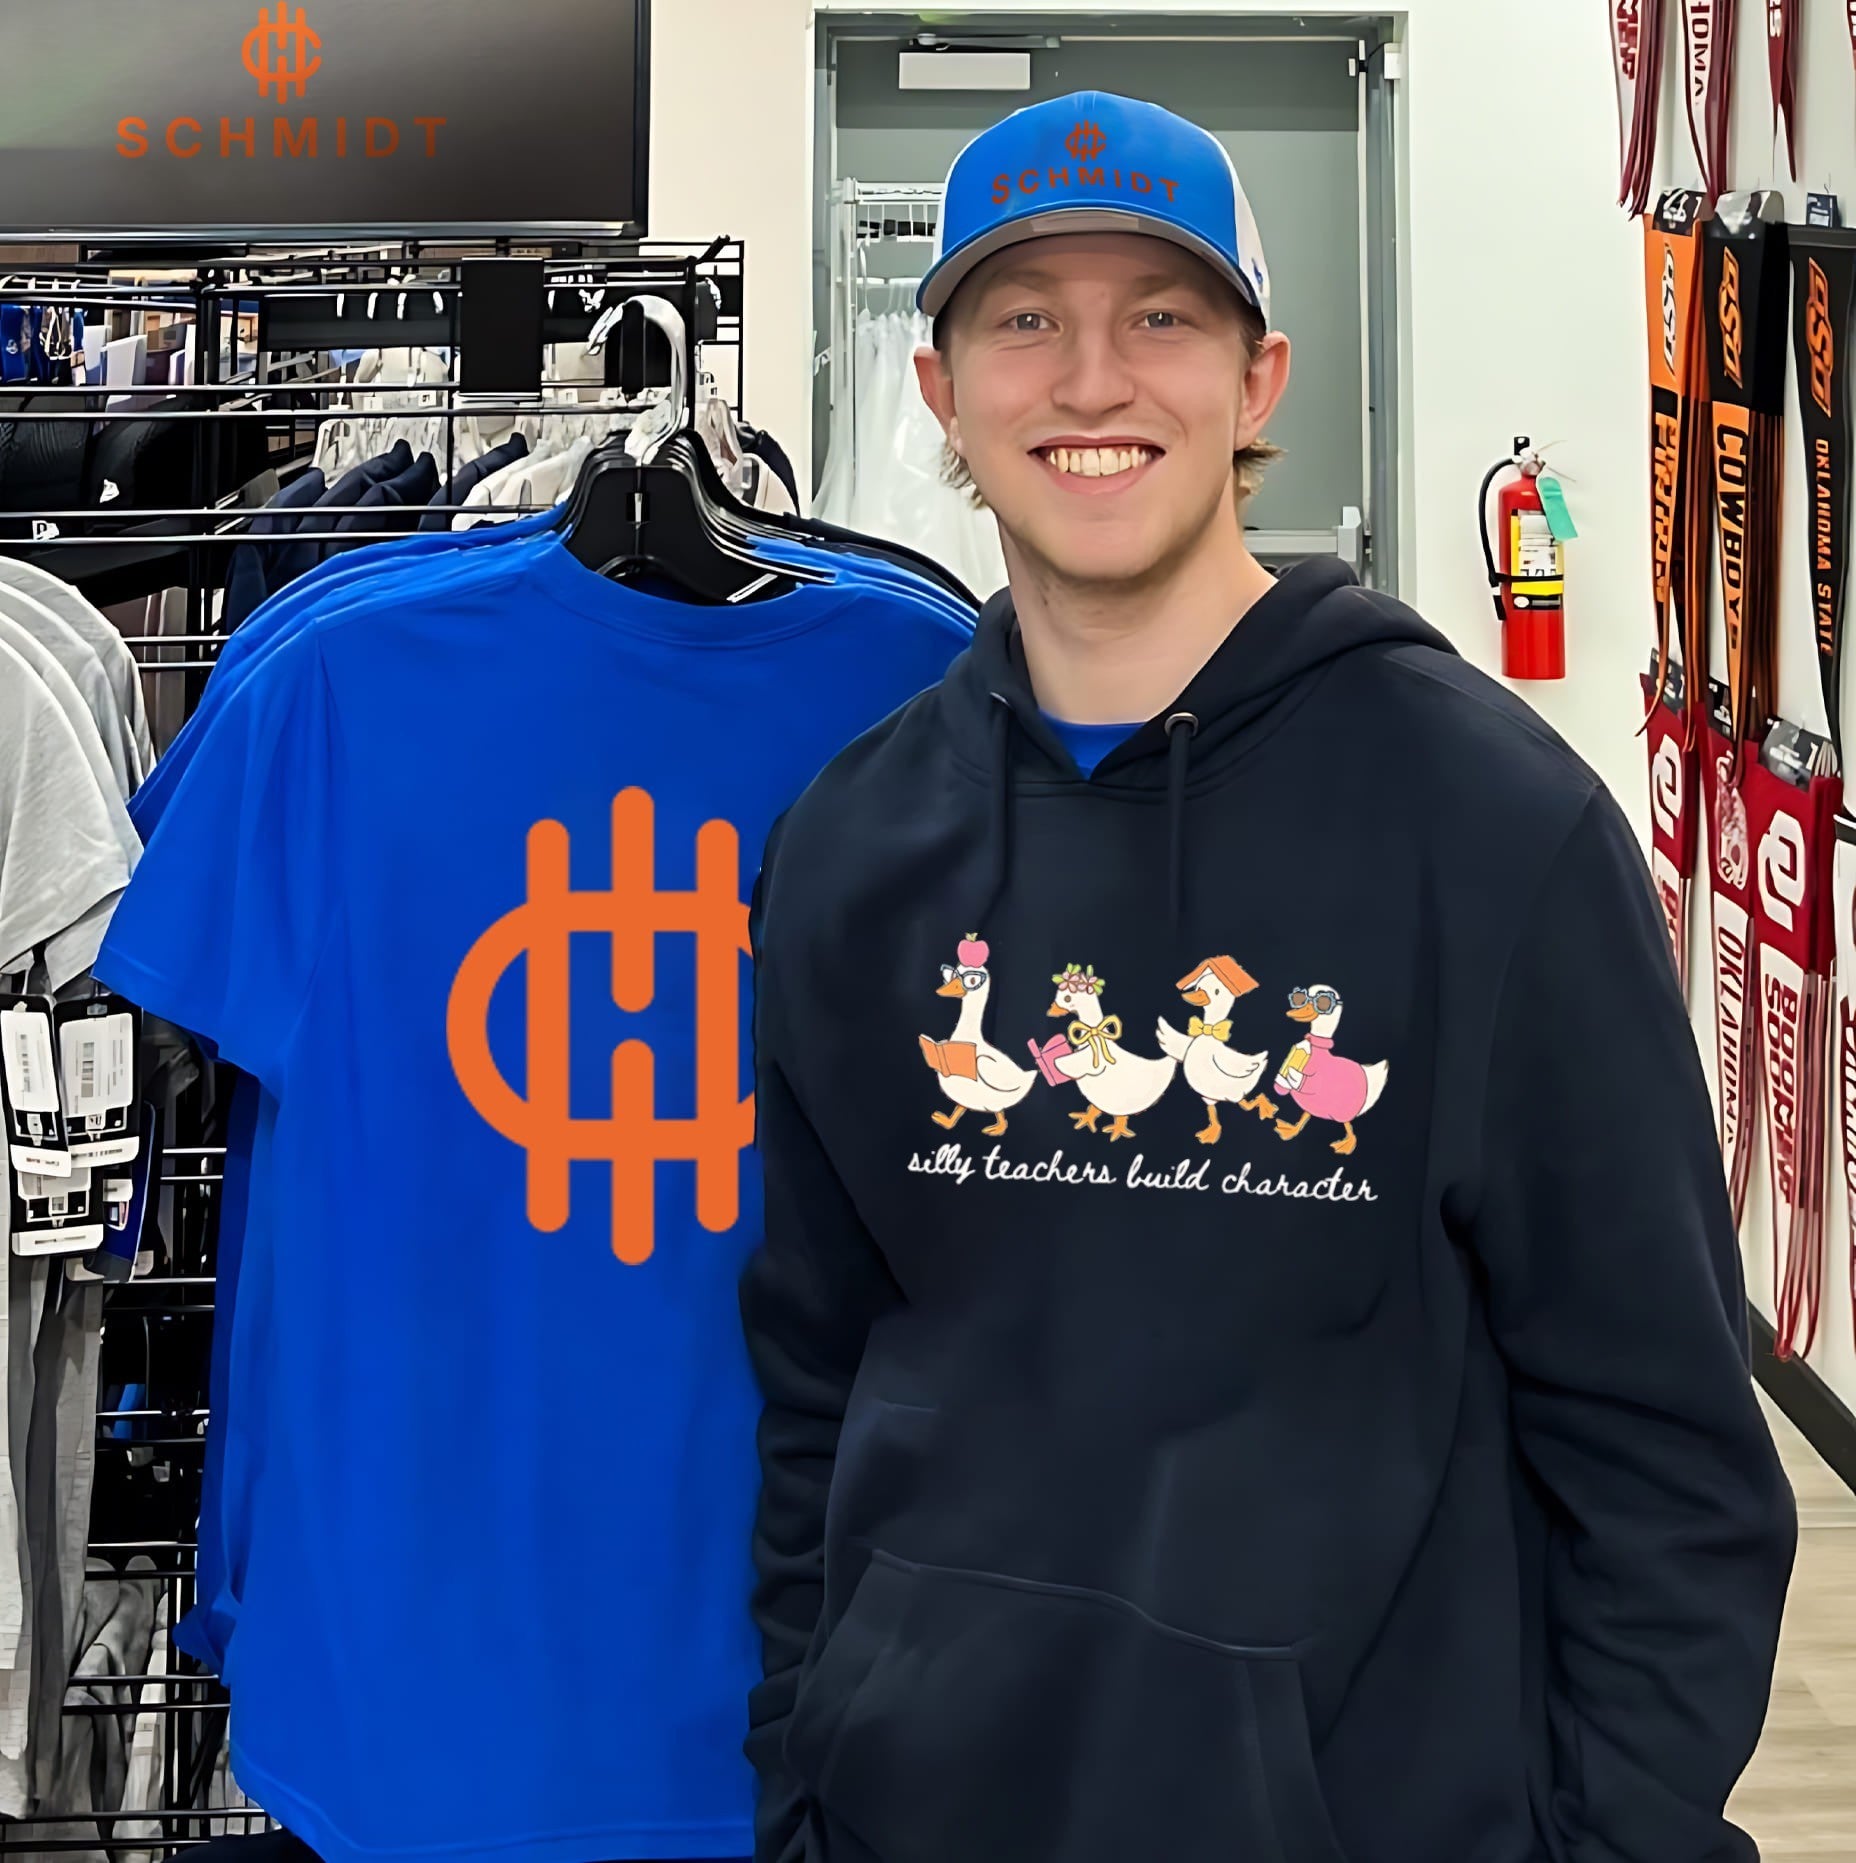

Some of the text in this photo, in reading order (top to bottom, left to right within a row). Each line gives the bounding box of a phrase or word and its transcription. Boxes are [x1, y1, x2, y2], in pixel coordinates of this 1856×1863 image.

[115, 116, 448, 159] SCHMIDT
[991, 166, 1180, 205] SCHMIDT
[907, 1143, 1379, 1202] silly teachers build character
